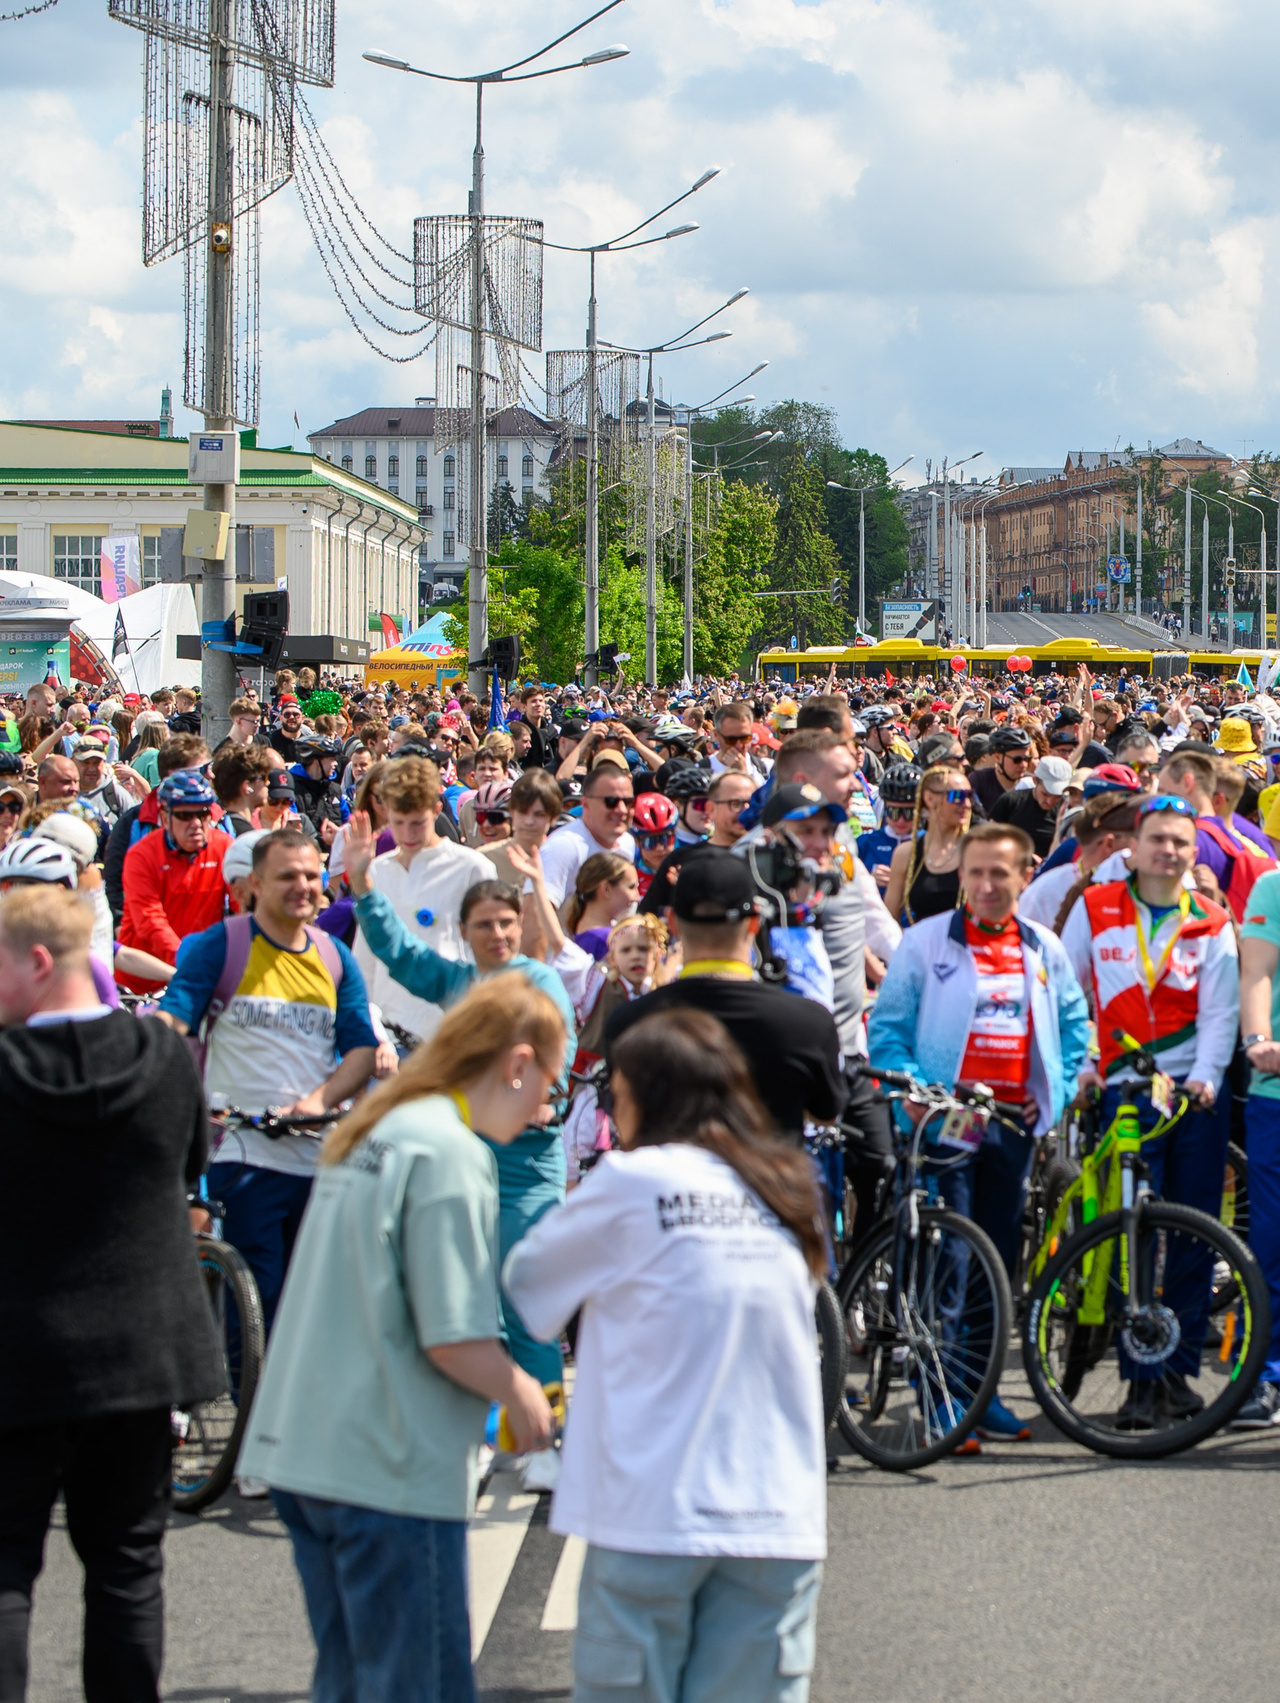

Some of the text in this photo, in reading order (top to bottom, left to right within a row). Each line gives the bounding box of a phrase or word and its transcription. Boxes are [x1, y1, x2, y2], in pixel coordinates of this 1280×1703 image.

[0, 662, 23, 670] ДАРОК
[369, 662, 433, 671] ВЕЛОСИПЕДНЫЙ
[0, 672, 18, 682] EPSI
